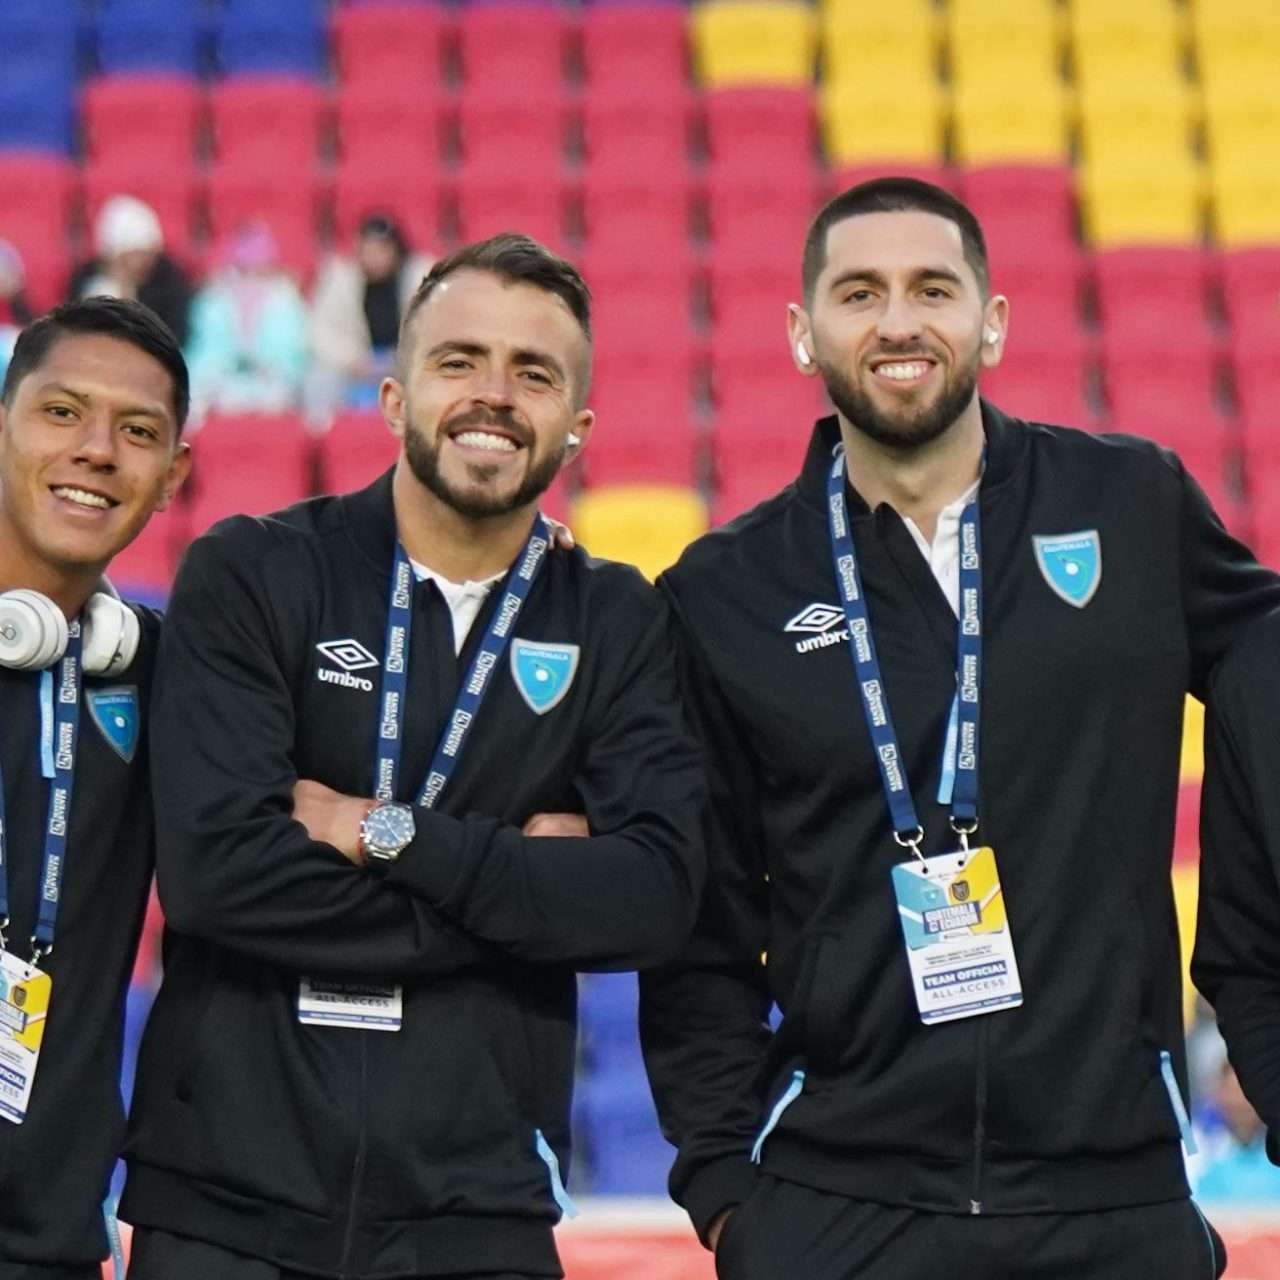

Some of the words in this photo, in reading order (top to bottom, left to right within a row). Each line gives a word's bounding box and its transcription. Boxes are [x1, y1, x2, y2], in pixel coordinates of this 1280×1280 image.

[317, 667, 373, 692] umbro
[925, 972, 956, 989] TEAM
[957, 963, 1007, 983] OFFICIAL
